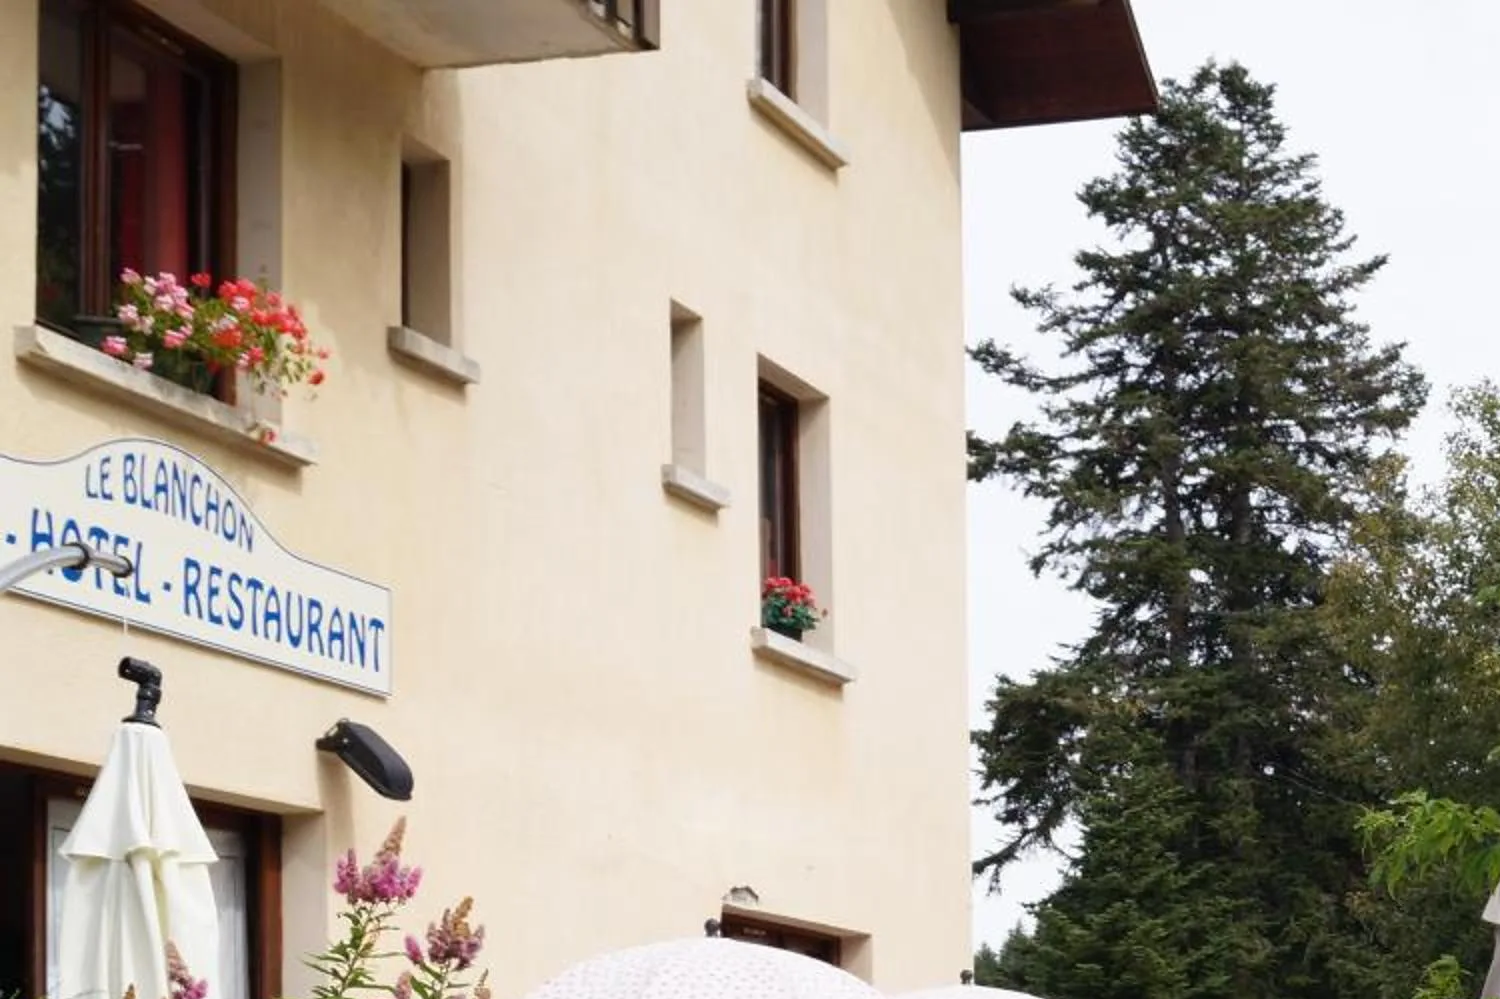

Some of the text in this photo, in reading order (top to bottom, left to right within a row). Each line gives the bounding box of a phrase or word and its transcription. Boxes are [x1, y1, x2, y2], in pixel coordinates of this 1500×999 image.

[84, 453, 253, 552] LE BLANCHON
[183, 558, 385, 673] RESTAURANT
